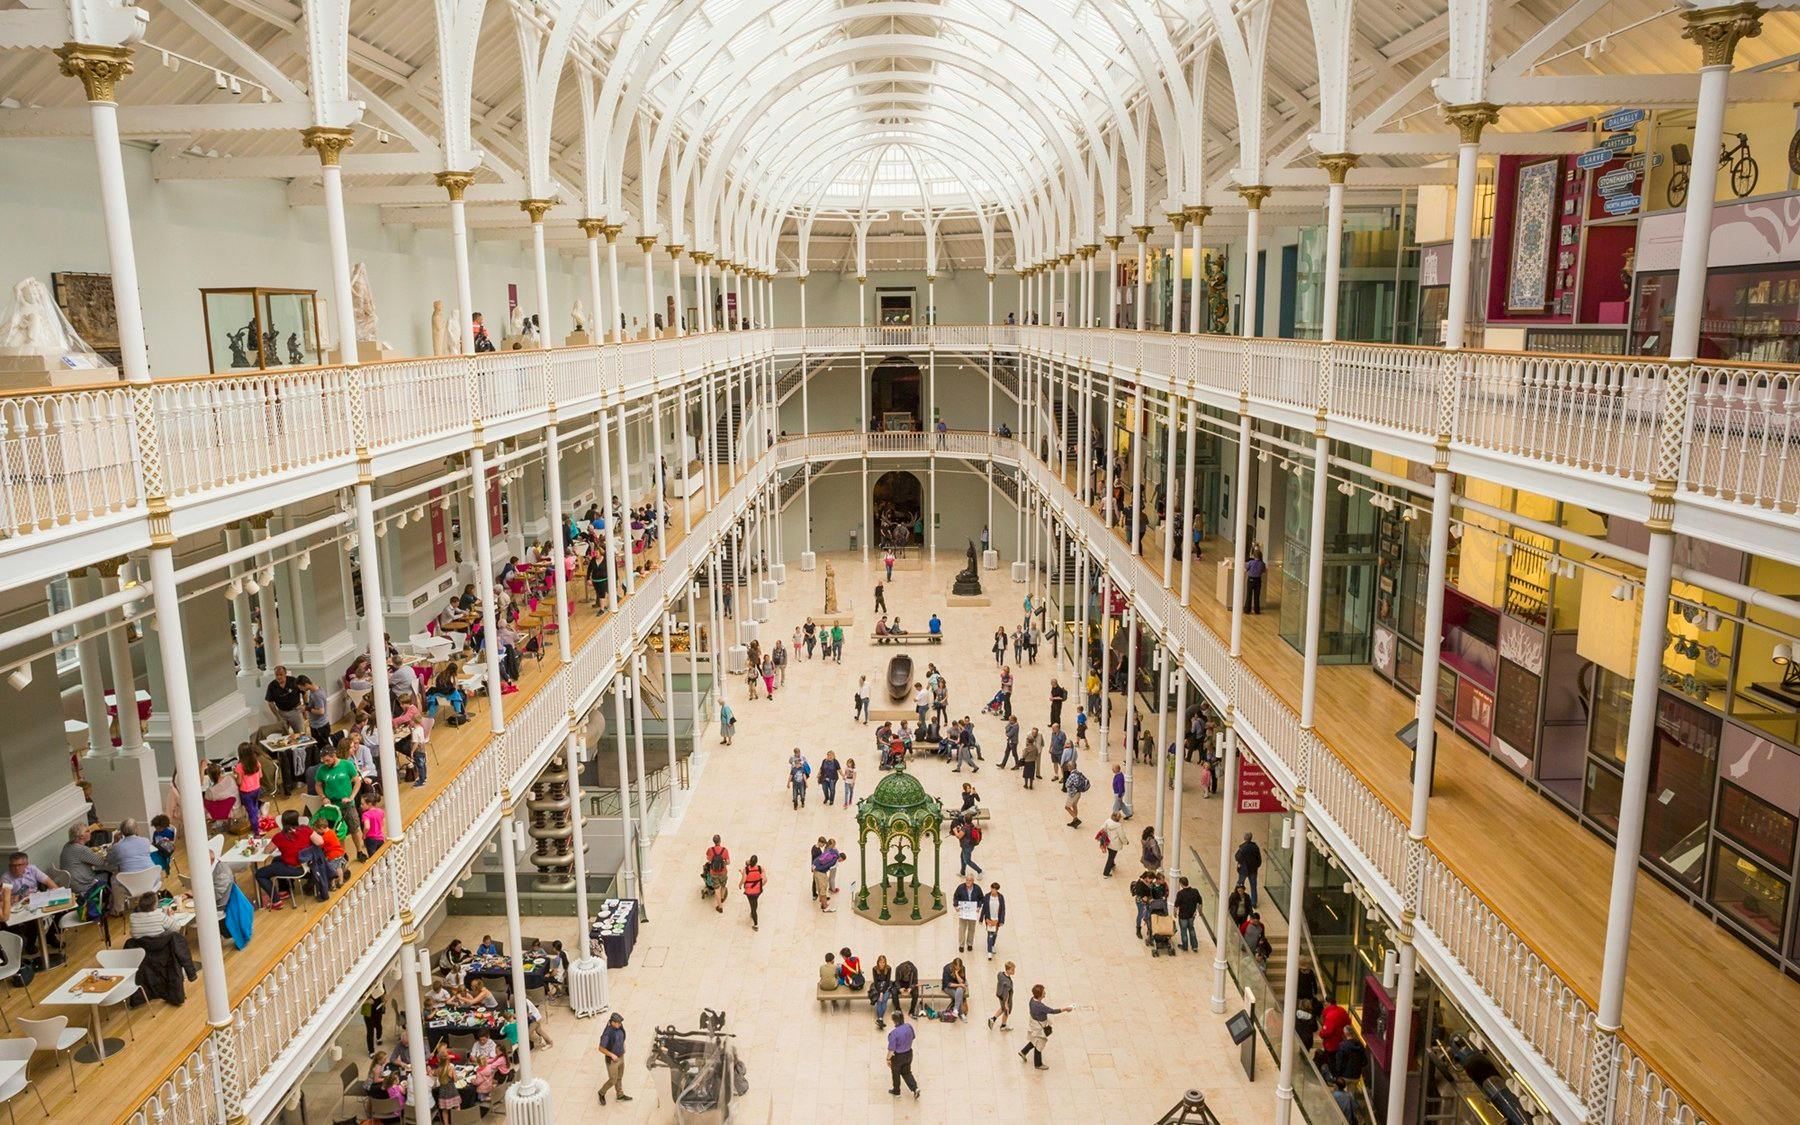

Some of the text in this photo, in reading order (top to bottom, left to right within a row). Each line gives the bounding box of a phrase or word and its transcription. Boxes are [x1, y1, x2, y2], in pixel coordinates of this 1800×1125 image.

[1608, 113, 1639, 126] DALMALLY
[1604, 138, 1632, 148] CARSTAIRS
[1584, 153, 1604, 164] GARVE
[1600, 172, 1634, 186] STONEHAVEN
[1605, 201, 1620, 210] NORTH
